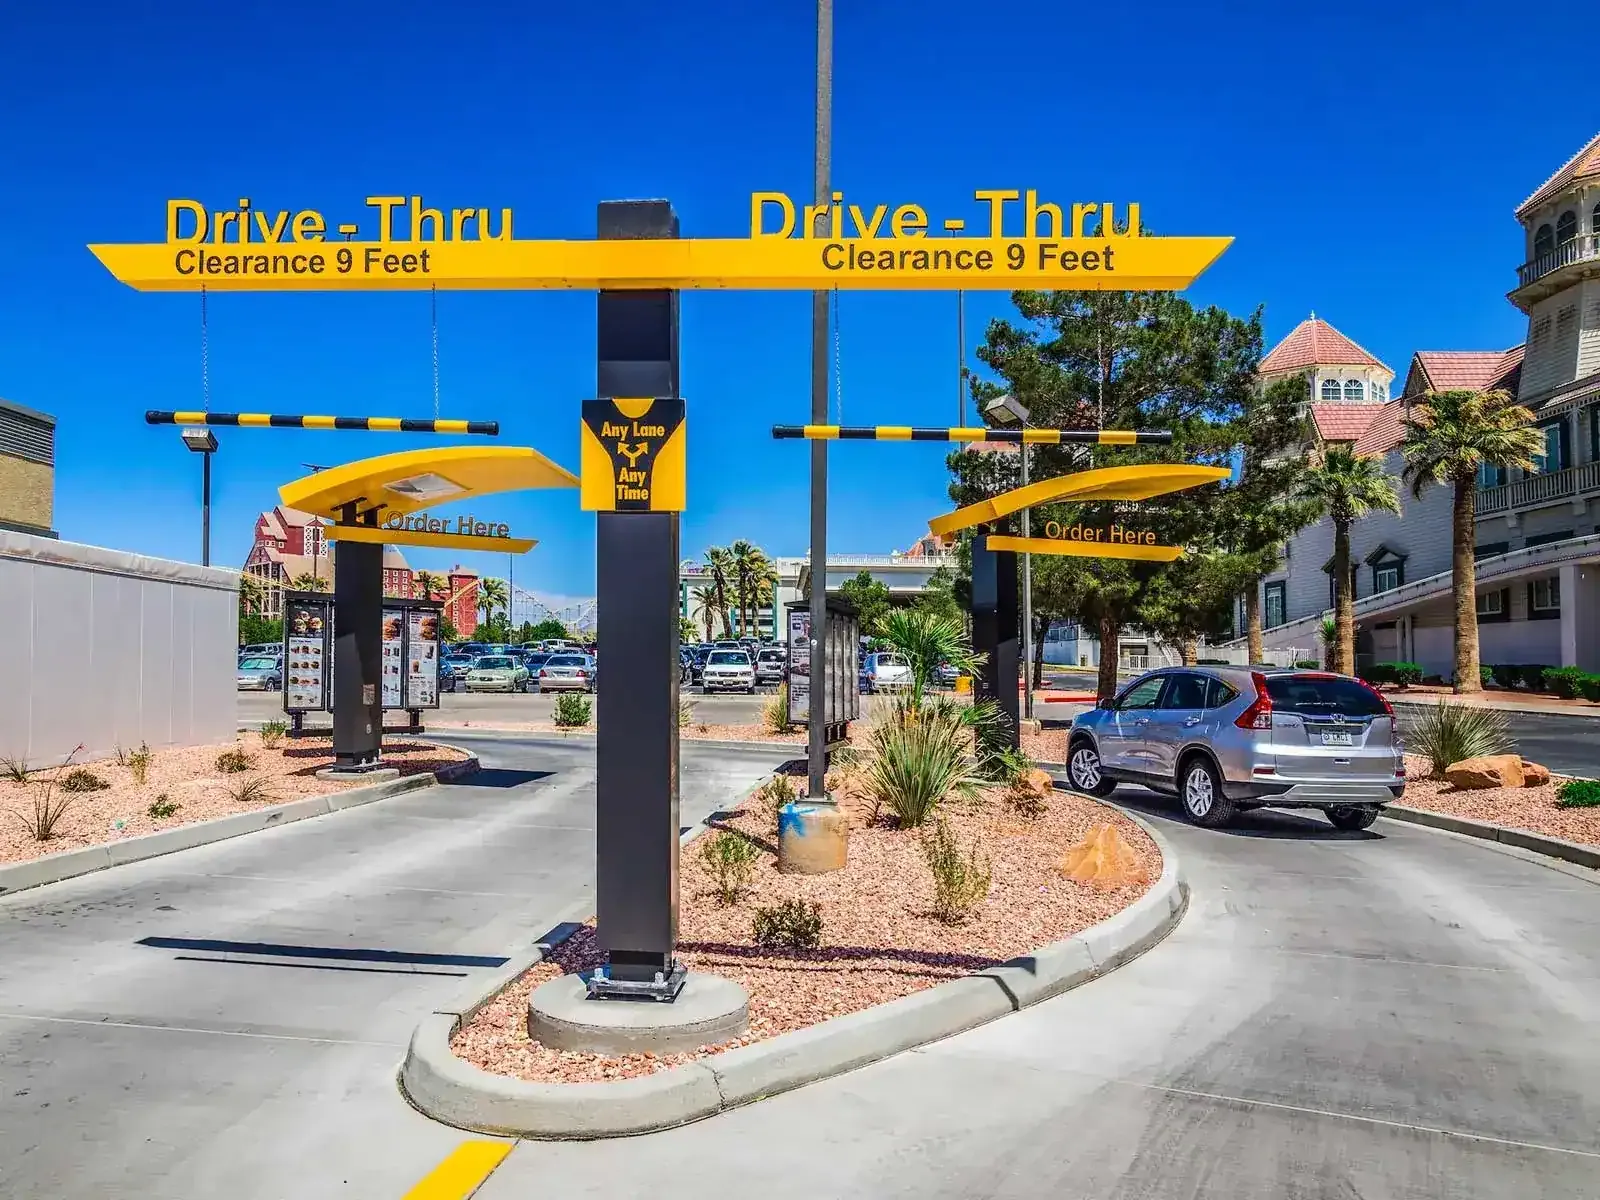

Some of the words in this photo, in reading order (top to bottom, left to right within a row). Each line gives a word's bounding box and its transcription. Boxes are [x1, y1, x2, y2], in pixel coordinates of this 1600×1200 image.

[166, 198, 328, 244] Drive
[365, 195, 513, 243] Thru
[750, 191, 929, 240] Drive
[975, 188, 1141, 239] Thru
[175, 249, 325, 275] Clearance
[336, 248, 353, 274] 9
[364, 248, 431, 274] Feet
[821, 243, 993, 271] Clearance
[1007, 243, 1025, 271] 9
[1039, 243, 1115, 271] Feet
[601, 421, 629, 441] Any
[632, 421, 665, 437] Lane
[618, 467, 647, 487] Any
[616, 484, 649, 500] Time
[385, 510, 451, 533] Order
[457, 515, 510, 538] Here
[1045, 520, 1103, 541] Order
[1110, 524, 1156, 545] Here
